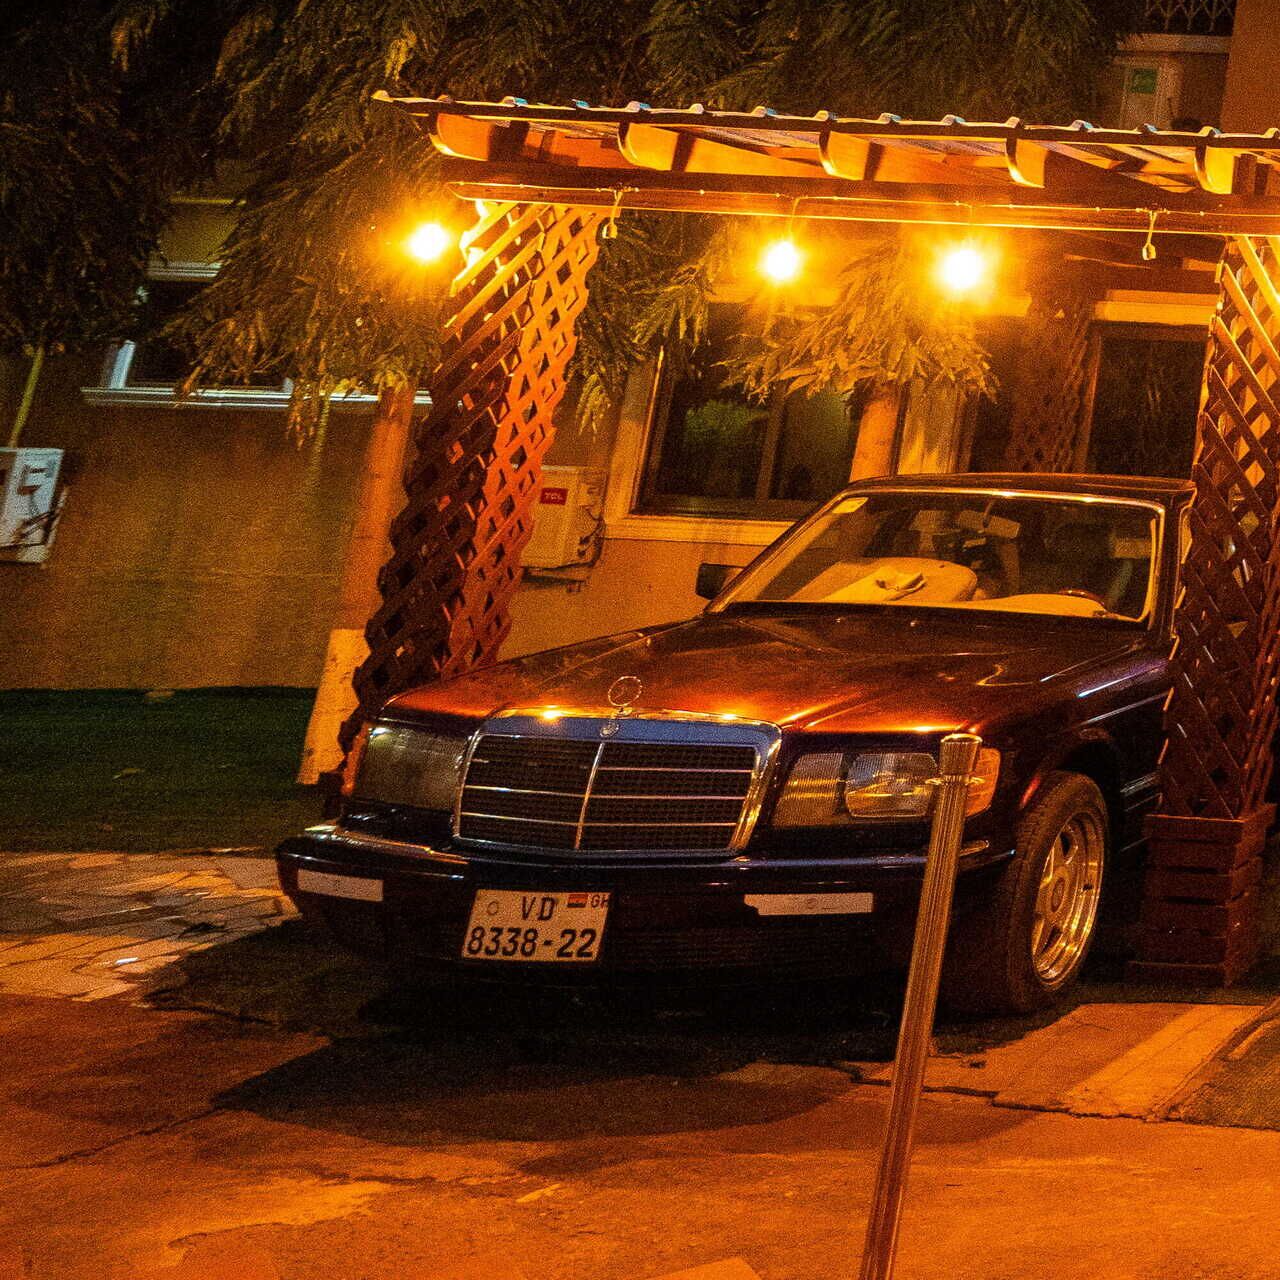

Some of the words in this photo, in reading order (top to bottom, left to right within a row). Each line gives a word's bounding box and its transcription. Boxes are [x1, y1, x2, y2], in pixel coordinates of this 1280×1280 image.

[544, 492, 564, 501] TCL
[521, 896, 556, 921] VD
[467, 926, 597, 958] 8338-22
